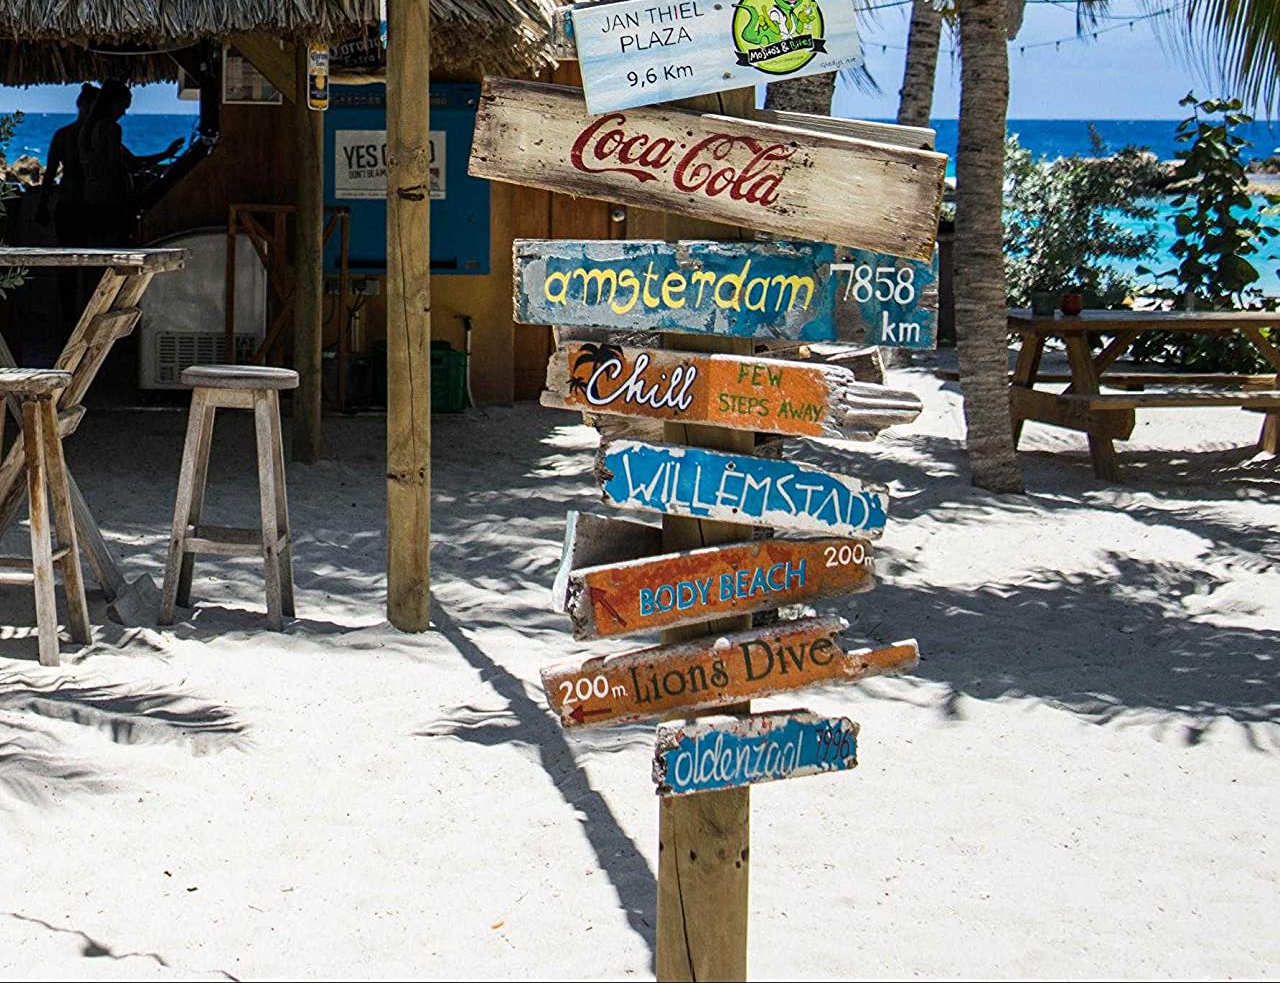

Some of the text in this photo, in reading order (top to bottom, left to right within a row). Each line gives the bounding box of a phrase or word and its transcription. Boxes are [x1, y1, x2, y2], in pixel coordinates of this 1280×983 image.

[600, 0, 705, 35] JAN THIEL
[619, 28, 692, 54] PLAZA
[626, 67, 658, 88] 9,6
[343, 144, 378, 169] YES
[543, 259, 916, 315] amsterdam 7858
[881, 315, 920, 343] km
[586, 353, 696, 412] Chill
[737, 362, 783, 388] FEW
[718, 392, 825, 424] STEPS AWAY
[622, 453, 870, 529] WILLEMSTAD
[639, 558, 807, 617] BODY BEACH
[628, 655, 729, 705] Lions
[743, 635, 836, 683] Dive
